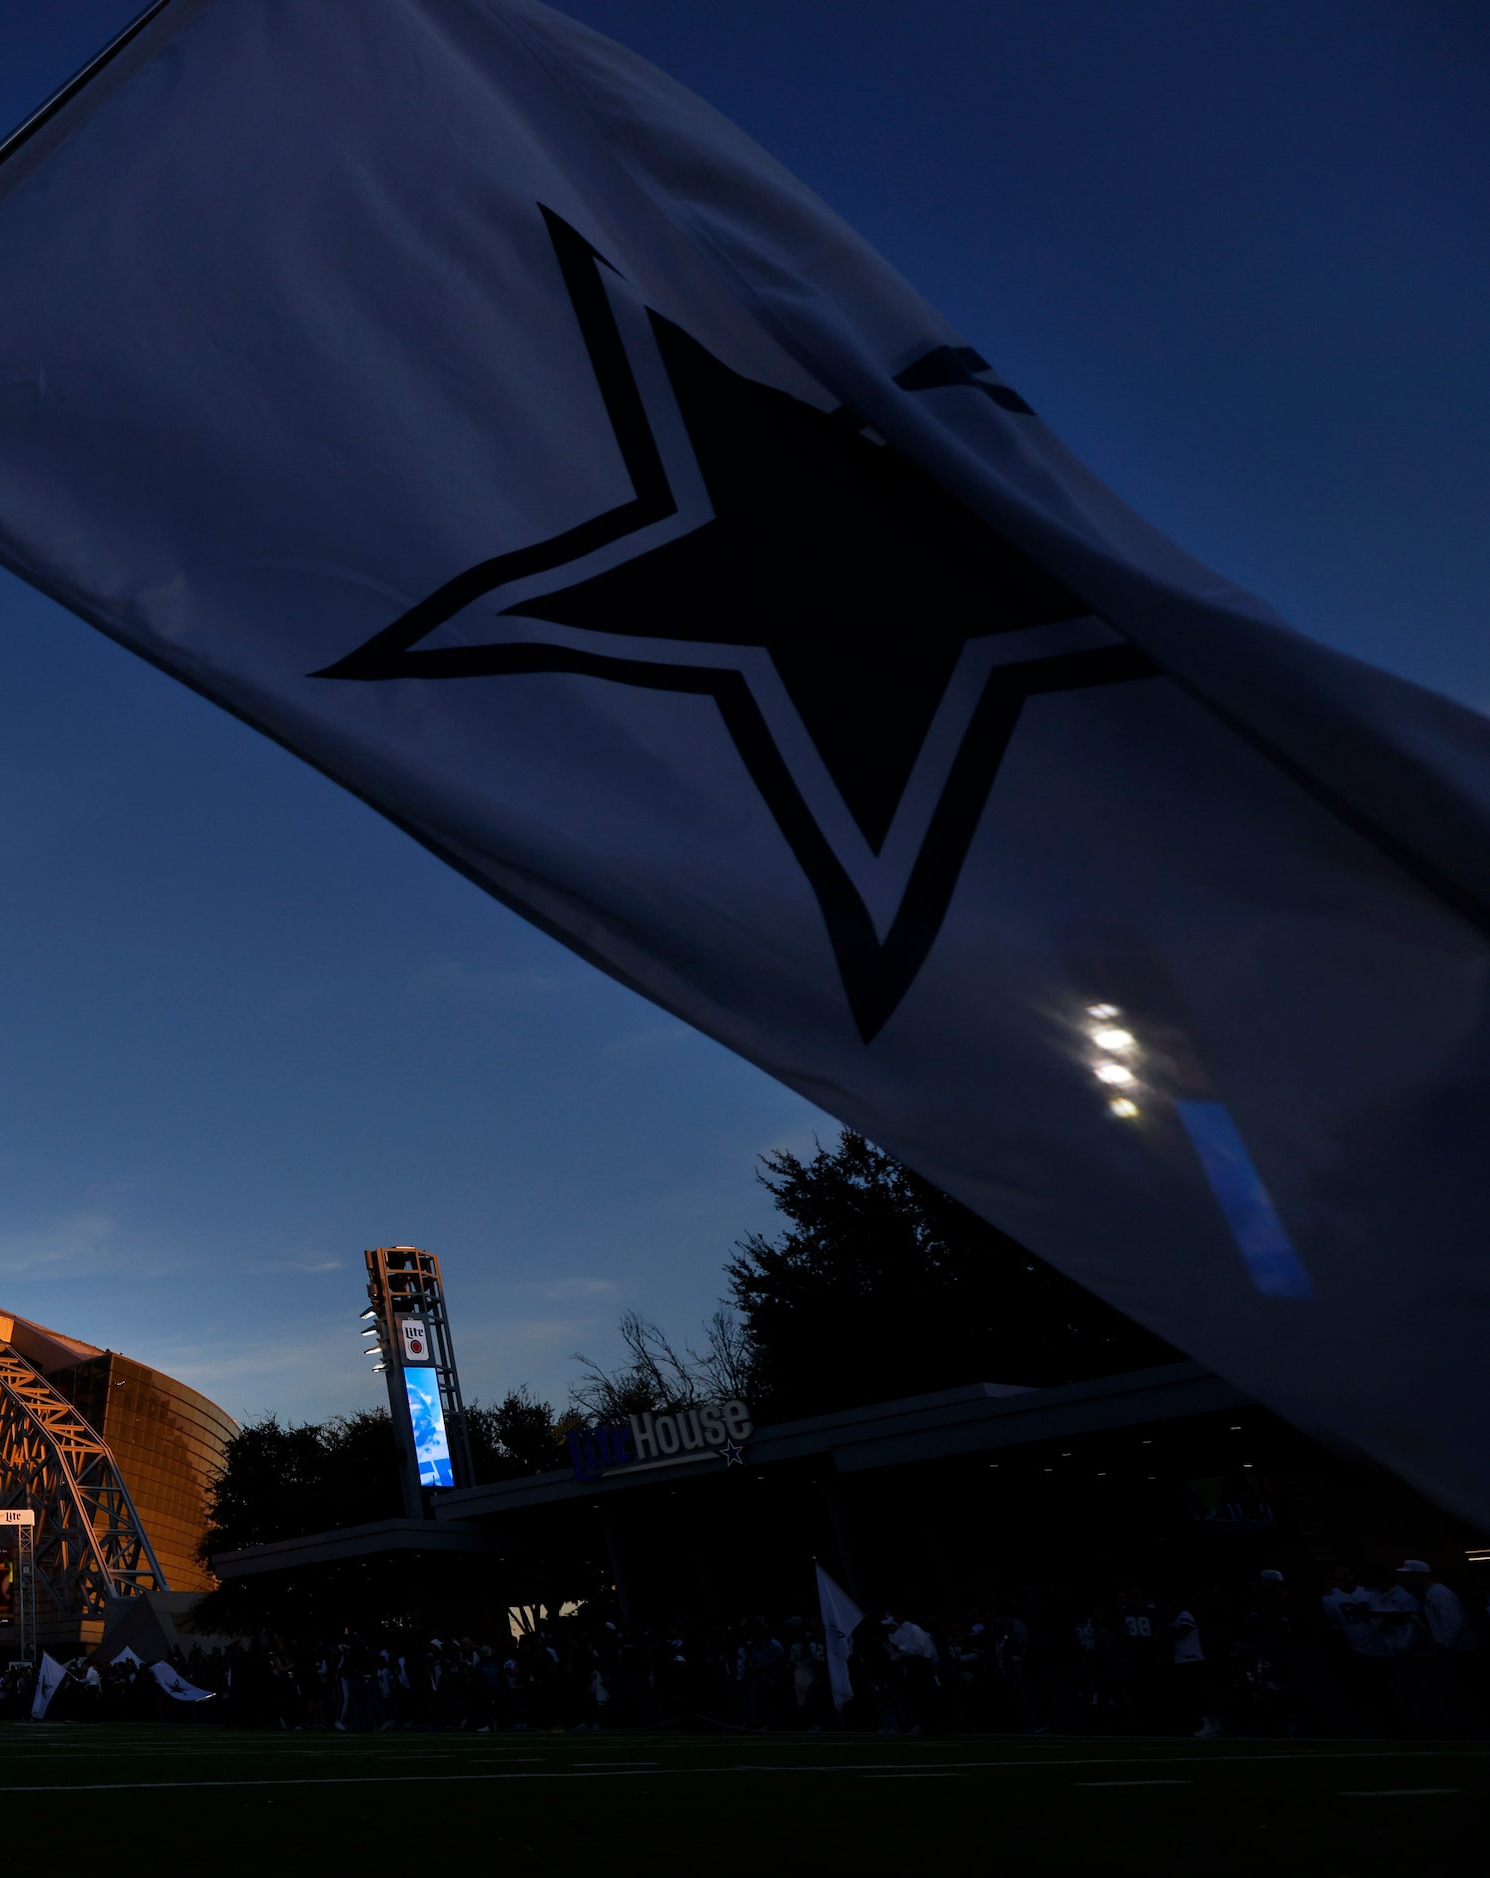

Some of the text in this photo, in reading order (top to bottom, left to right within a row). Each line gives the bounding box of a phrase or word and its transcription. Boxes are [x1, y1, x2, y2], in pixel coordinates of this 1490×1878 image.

[405, 1327, 424, 1340] Lite
[6, 1512, 21, 1523] Lite
[1124, 1616, 1151, 1638] 88
